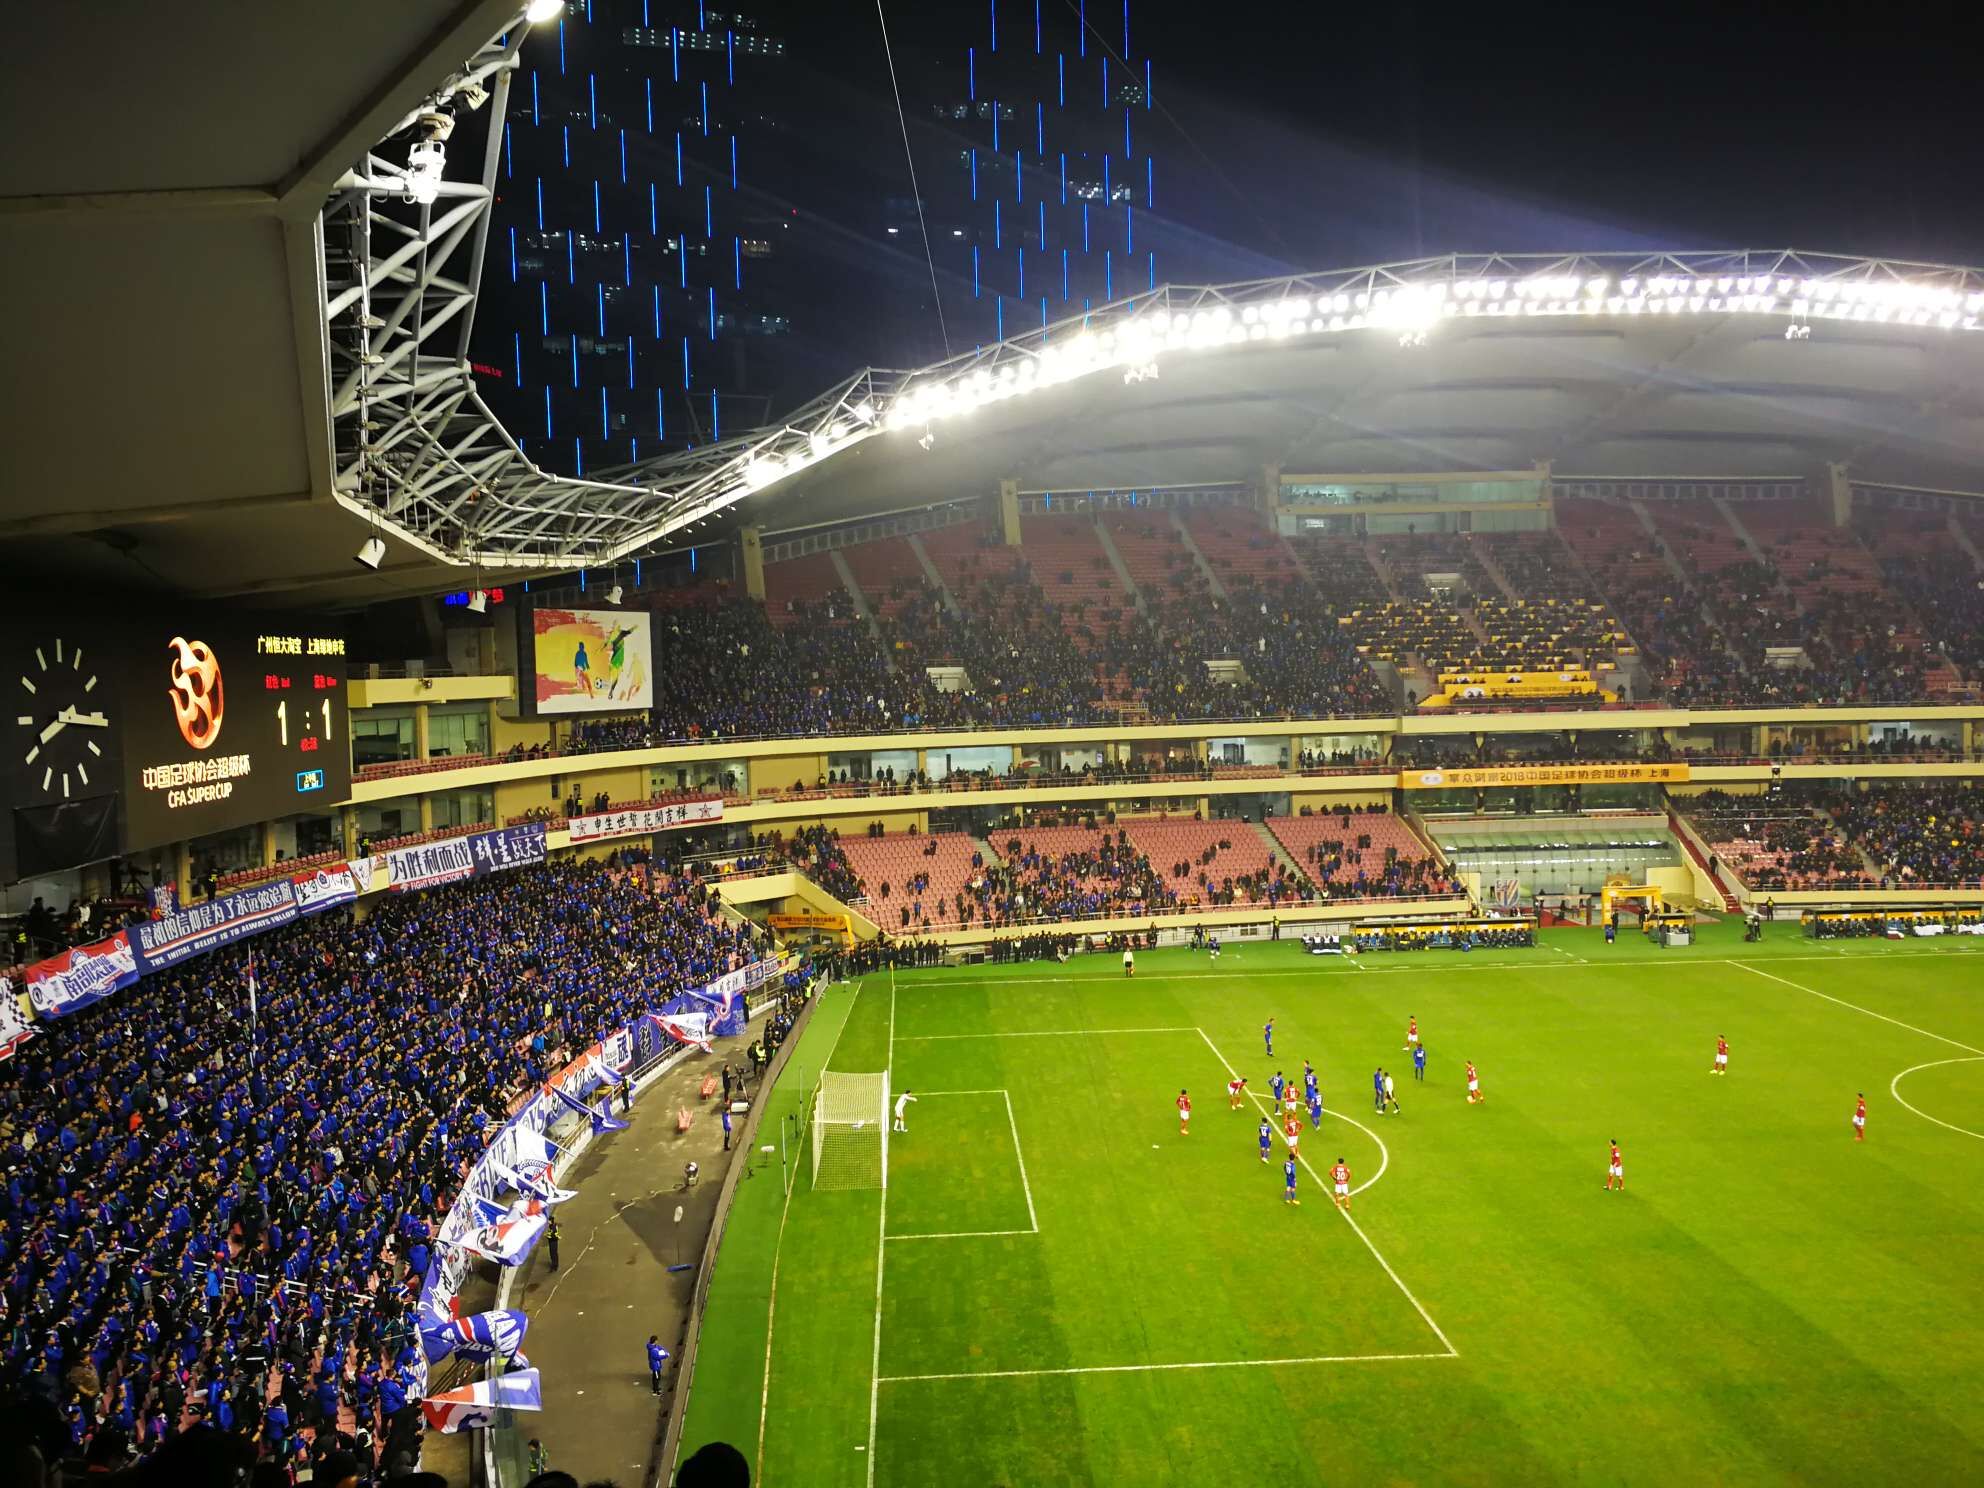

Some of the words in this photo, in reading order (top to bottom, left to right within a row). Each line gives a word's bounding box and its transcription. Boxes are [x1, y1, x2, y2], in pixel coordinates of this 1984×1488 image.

[257, 635, 302, 655] 广州恒大淘宝
[142, 754, 251, 790] 中国足球协会超级杯
[168, 789, 187, 808] CFA
[187, 784, 216, 805] SUPER
[216, 782, 232, 799] CUP
[390, 842, 472, 882] 为胜利而战
[411, 878, 429, 891] FIGHT
[429, 876, 441, 887] FOR
[441, 871, 464, 884] VICTORY
[150, 957, 165, 967] THE
[193, 936, 217, 949] BELIEF
[230, 927, 240, 937] TO
[241, 917, 271, 933] ALWAYS
[271, 909, 296, 924] FOLLOW
